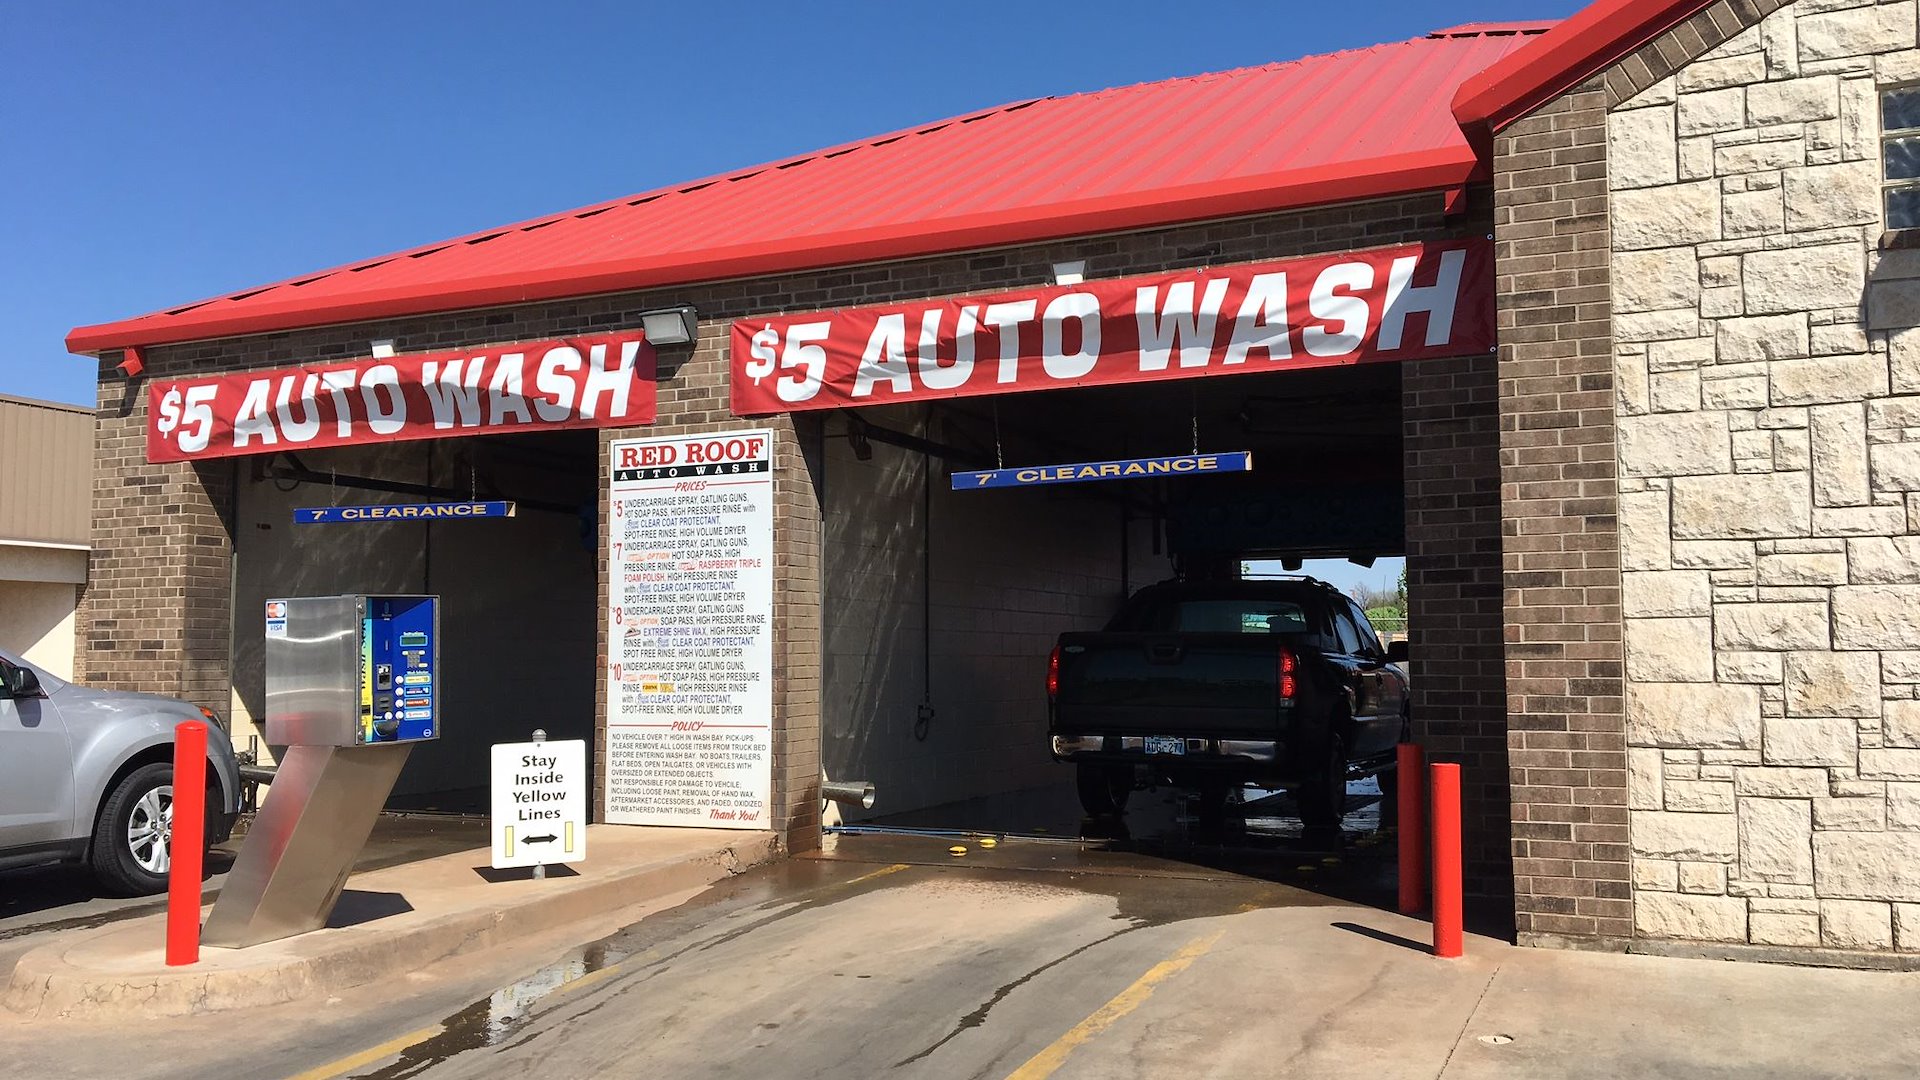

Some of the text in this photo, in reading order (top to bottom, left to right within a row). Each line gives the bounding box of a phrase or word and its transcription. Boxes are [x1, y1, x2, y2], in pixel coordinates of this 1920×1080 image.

[744, 248, 1468, 404] $5 AUTO WASH
[157, 340, 641, 453] $5 AUTO WASH
[621, 439, 763, 467] RED ROOF
[620, 463, 759, 480] AUTO WASH
[975, 455, 1218, 486] 7' CLEARANCE
[674, 481, 707, 491] PRICES
[625, 494, 727, 508] UNDERCARRIAGE SPRAY, GATLING
[311, 504, 487, 520] 7' CLEARANCE
[613, 500, 622, 517] $5
[634, 503, 756, 518] SOAP PASS, HIGH PRESSURE RINSE with
[641, 517, 660, 527] CLEAR
[662, 517, 679, 526] COAT
[680, 516, 721, 526] PROTECTANT,
[625, 525, 746, 539] SPOT-FREE RINSE, HIGH VOLUME DRYER
[624, 538, 749, 551] UNDERCARRIAGE SPRAY, GATLING GUNS,
[672, 551, 685, 559] HOT
[686, 550, 703, 558] SOAP
[705, 550, 723, 558] PASS,
[624, 562, 655, 571] PRESSURE
[658, 562, 676, 570] RINSE,
[699, 560, 737, 569] RASPBERRY
[739, 559, 761, 567] TRIPLE
[625, 570, 737, 582] FOAM HIGH PRESSURE RINSE
[653, 583, 673, 592] CLEAR
[675, 582, 691, 591] COAT
[693, 582, 735, 591] PROTECTANT,
[624, 592, 745, 603] SPOT-FREE RINSE, HIGH VOLUME DRYER
[624, 604, 744, 616] UNDERCARRIAGE SPRAY, GATLING GUNS
[660, 614, 766, 625] SOAP PASS, HIGH PRESSURE RINSE,
[644, 627, 671, 636] EXTREME
[673, 626, 691, 636] SHINE
[710, 626, 725, 635] HIGH
[727, 626, 760, 635] PRESSURE
[623, 639, 641, 647] RINSE
[672, 638, 692, 646] CLEAR
[694, 638, 711, 646] COAT
[712, 637, 755, 646] PROTECTANT,
[623, 648, 742, 658] SPOT FREE RINSE, HIGH VOLUME DRYER
[623, 662, 745, 671] UNDERCARRIAGE SPRAY, GATLING GUNS,
[659, 672, 759, 682] HOT SOAP PASS, HIGH PRESSURE
[622, 684, 641, 692] RINSE,
[678, 684, 692, 692] HIGH
[694, 684, 727, 692] PRESSURE
[729, 684, 747, 692] RINSE
[650, 695, 670, 704] CLEAR
[672, 695, 688, 703] COAT
[690, 695, 732, 704] PROTECTANT,
[622, 705, 742, 714] SPOT-FREE RINSE, HIGH VOLUME DRYER
[671, 721, 703, 732] POLICY
[522, 755, 557, 769] Stay
[516, 772, 563, 785] Inside
[513, 790, 566, 803] Yellow
[611, 796, 652, 804] AFTERMARKET
[519, 809, 561, 821] Lines
[709, 809, 759, 821] Thank You!
